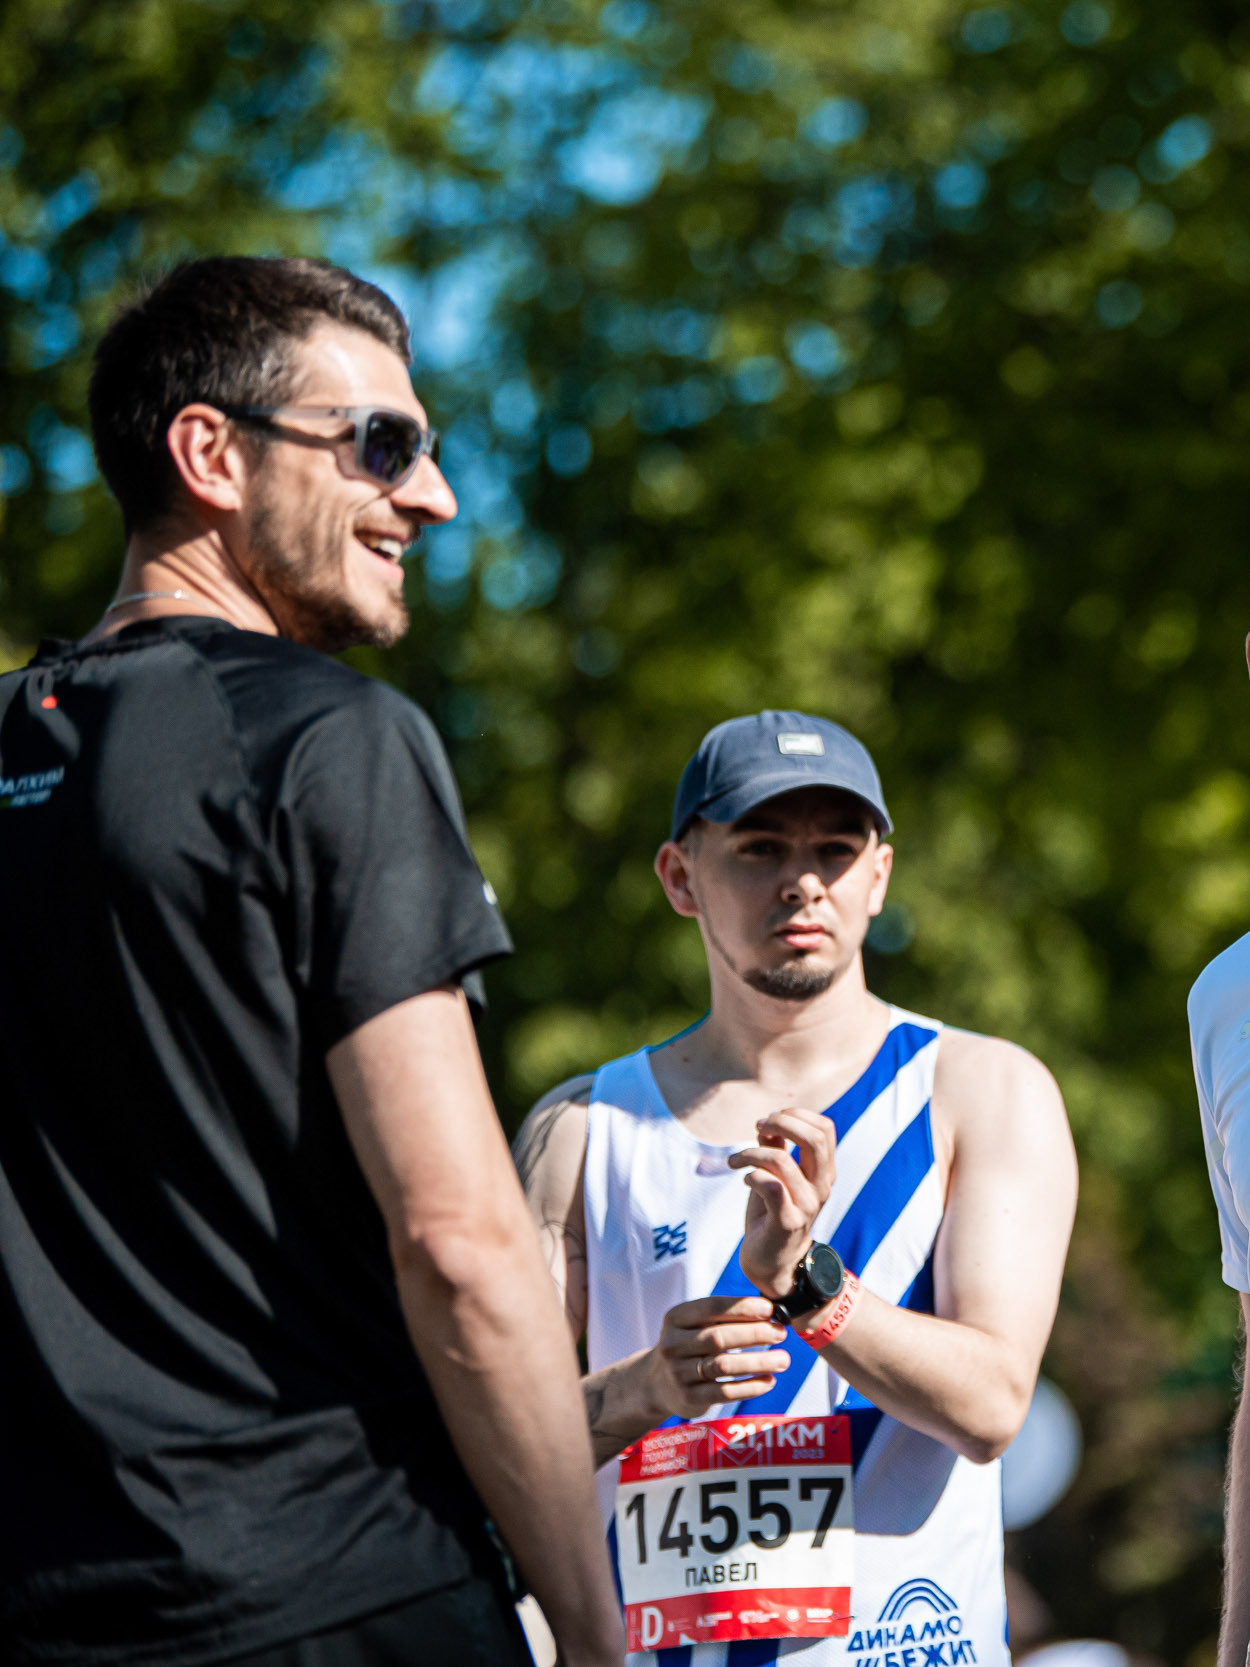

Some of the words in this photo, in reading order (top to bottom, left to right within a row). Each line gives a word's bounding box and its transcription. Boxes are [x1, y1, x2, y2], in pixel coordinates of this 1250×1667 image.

[821, 1293, 854, 1336] 14557
[792, 1448, 825, 1460] 2023
[625, 1477, 845, 1565] 14557
[685, 1562, 758, 1588] ПАВЕЛ
[641, 1607, 664, 1646] D
[847, 1615, 963, 1652] ДИНАМО
